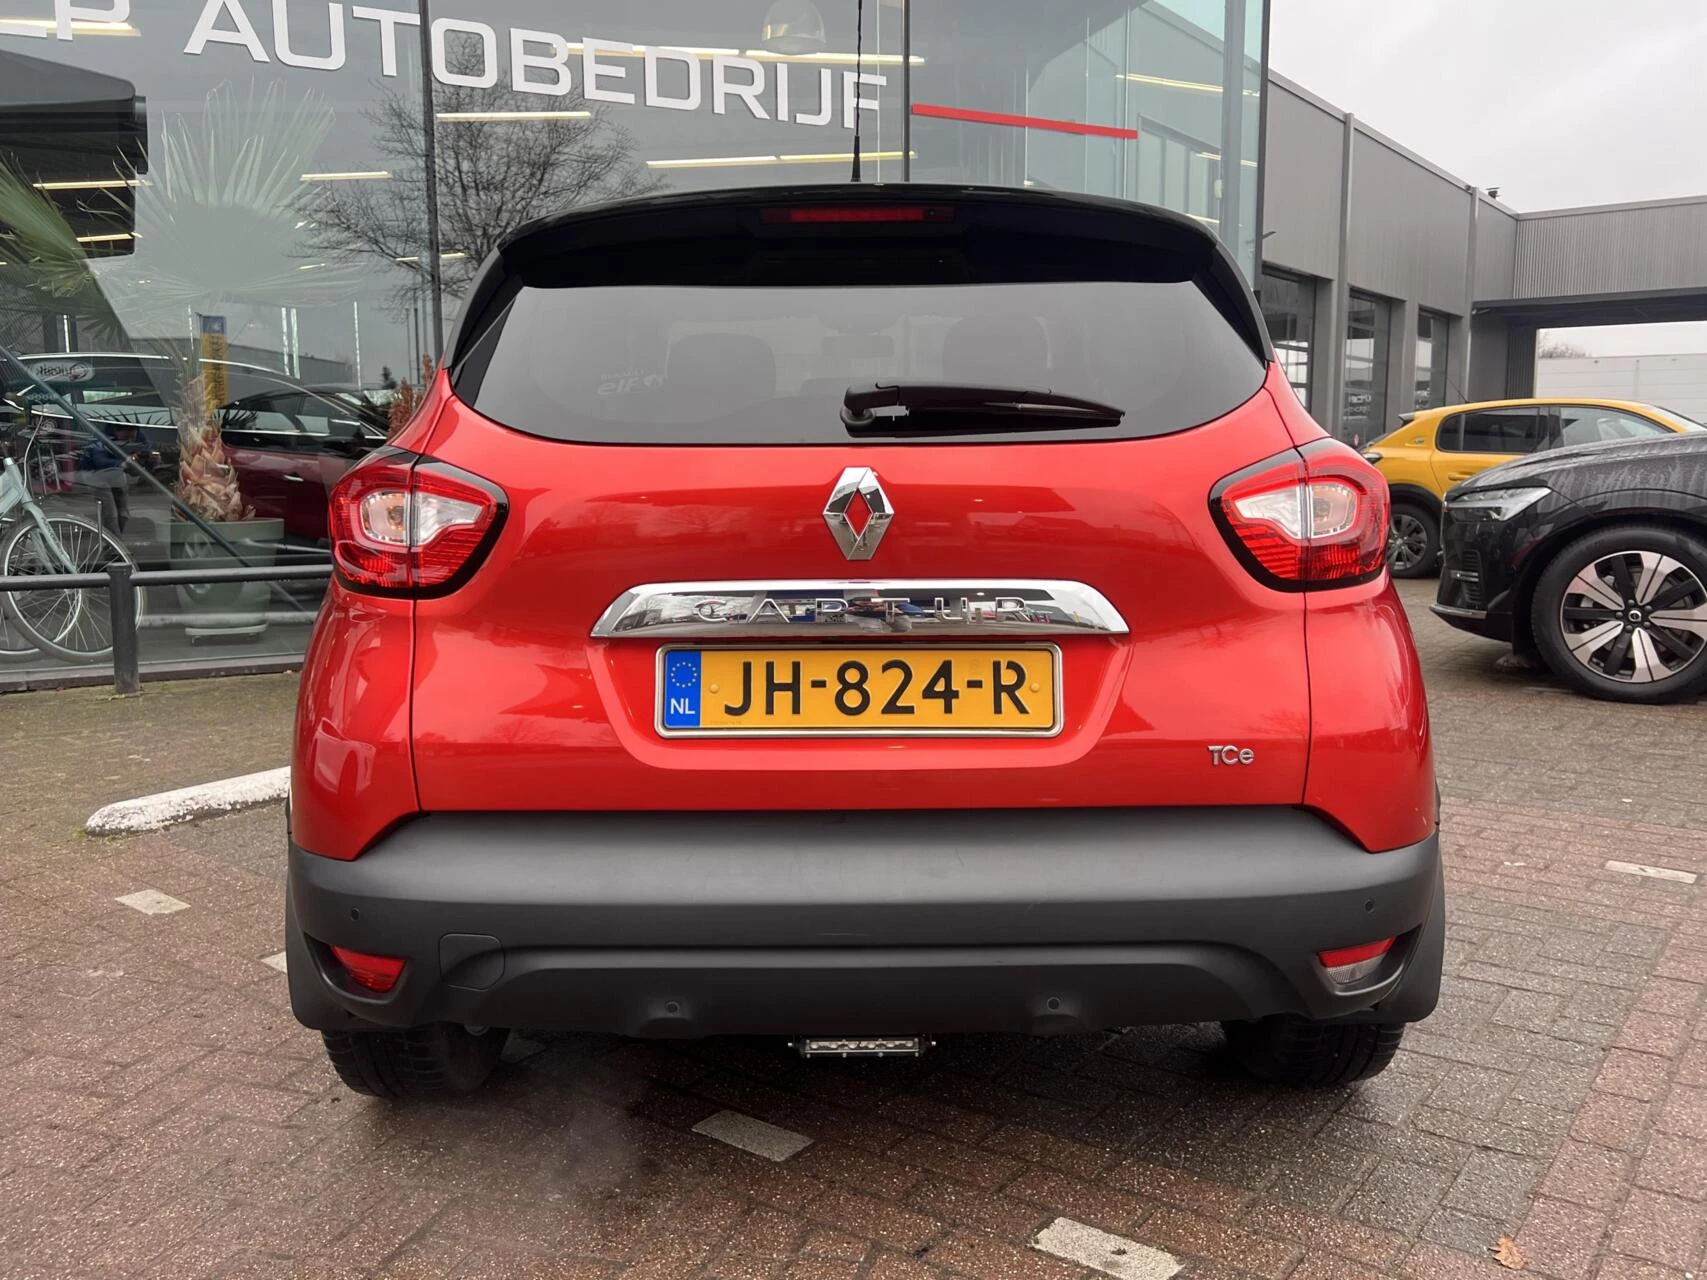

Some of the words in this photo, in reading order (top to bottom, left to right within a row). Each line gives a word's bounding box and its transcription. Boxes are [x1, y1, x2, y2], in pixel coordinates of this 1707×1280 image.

[0, 0, 130, 41] P
[184, 0, 887, 129] AUTOBEDRIJF
[693, 597, 1031, 624] CAPTUR
[724, 660, 1030, 717] JH-824-R
[670, 698, 696, 715] NL
[1207, 745, 1255, 765] TCe
